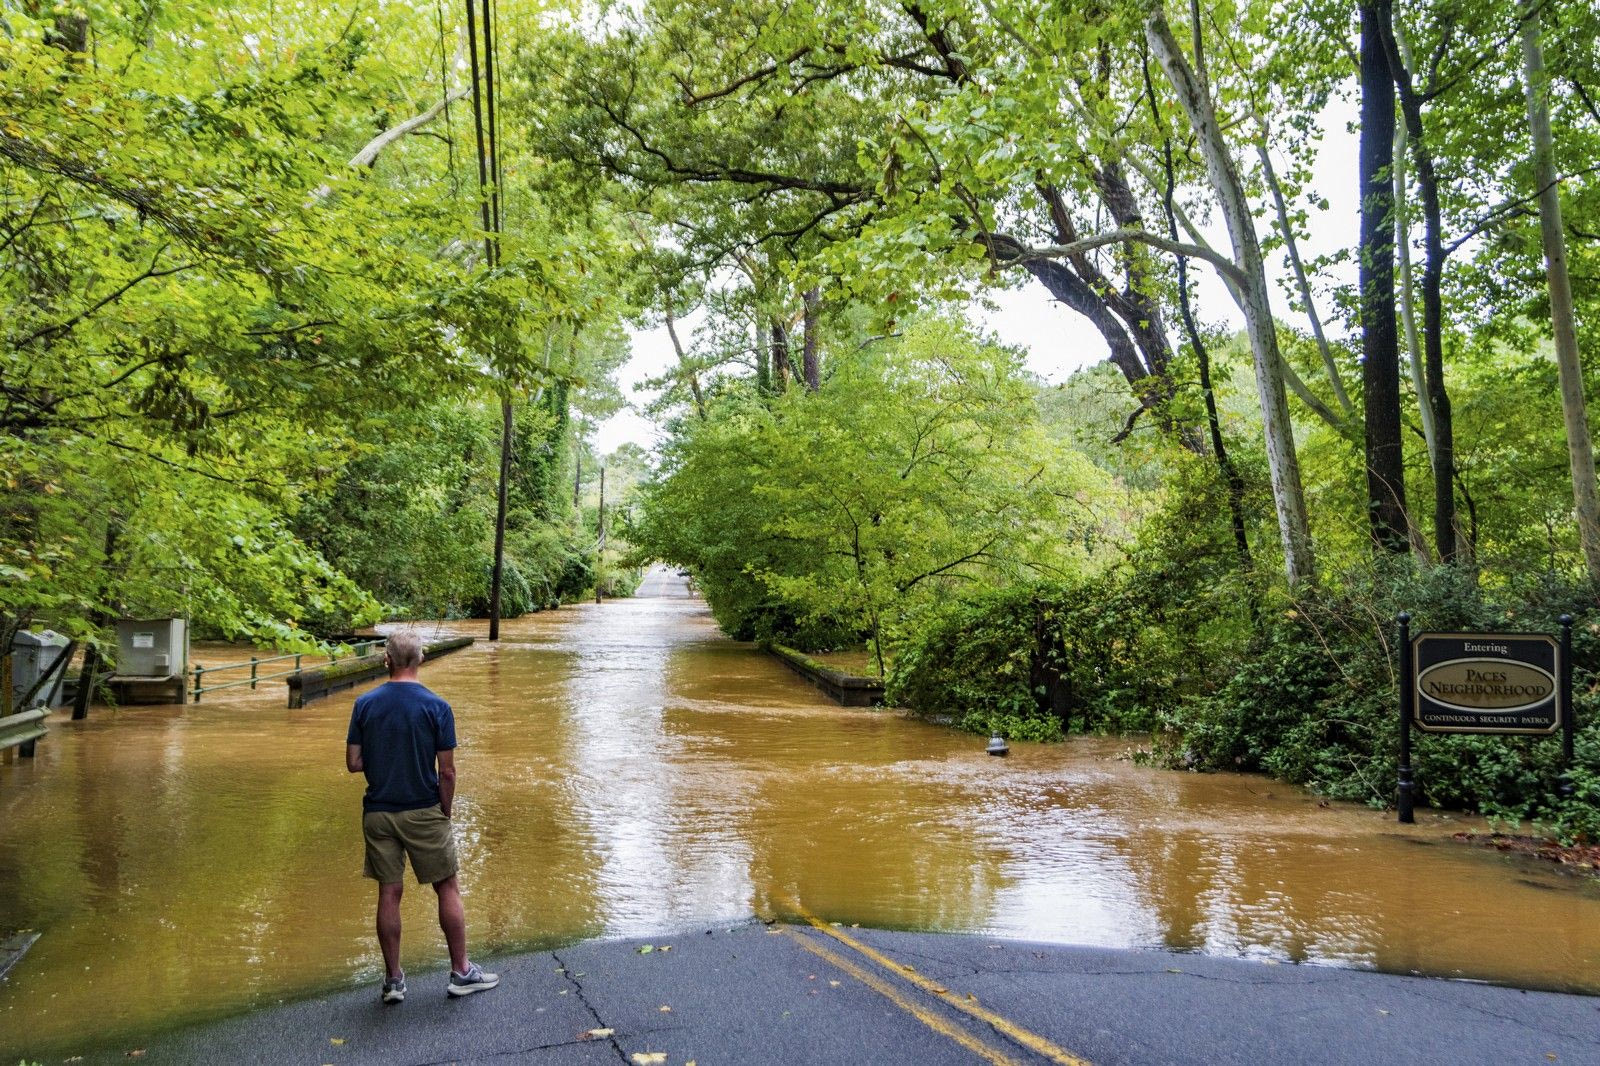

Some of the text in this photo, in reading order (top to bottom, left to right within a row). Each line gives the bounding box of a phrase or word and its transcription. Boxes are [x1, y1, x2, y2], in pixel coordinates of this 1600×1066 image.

[1464, 642, 1508, 654] Entering
[1466, 669, 1507, 682] PACES
[1430, 681, 1546, 696] NEIGHBORHOOD
[1424, 714, 1549, 724] CONTINUOUS SECURITY PATROL
